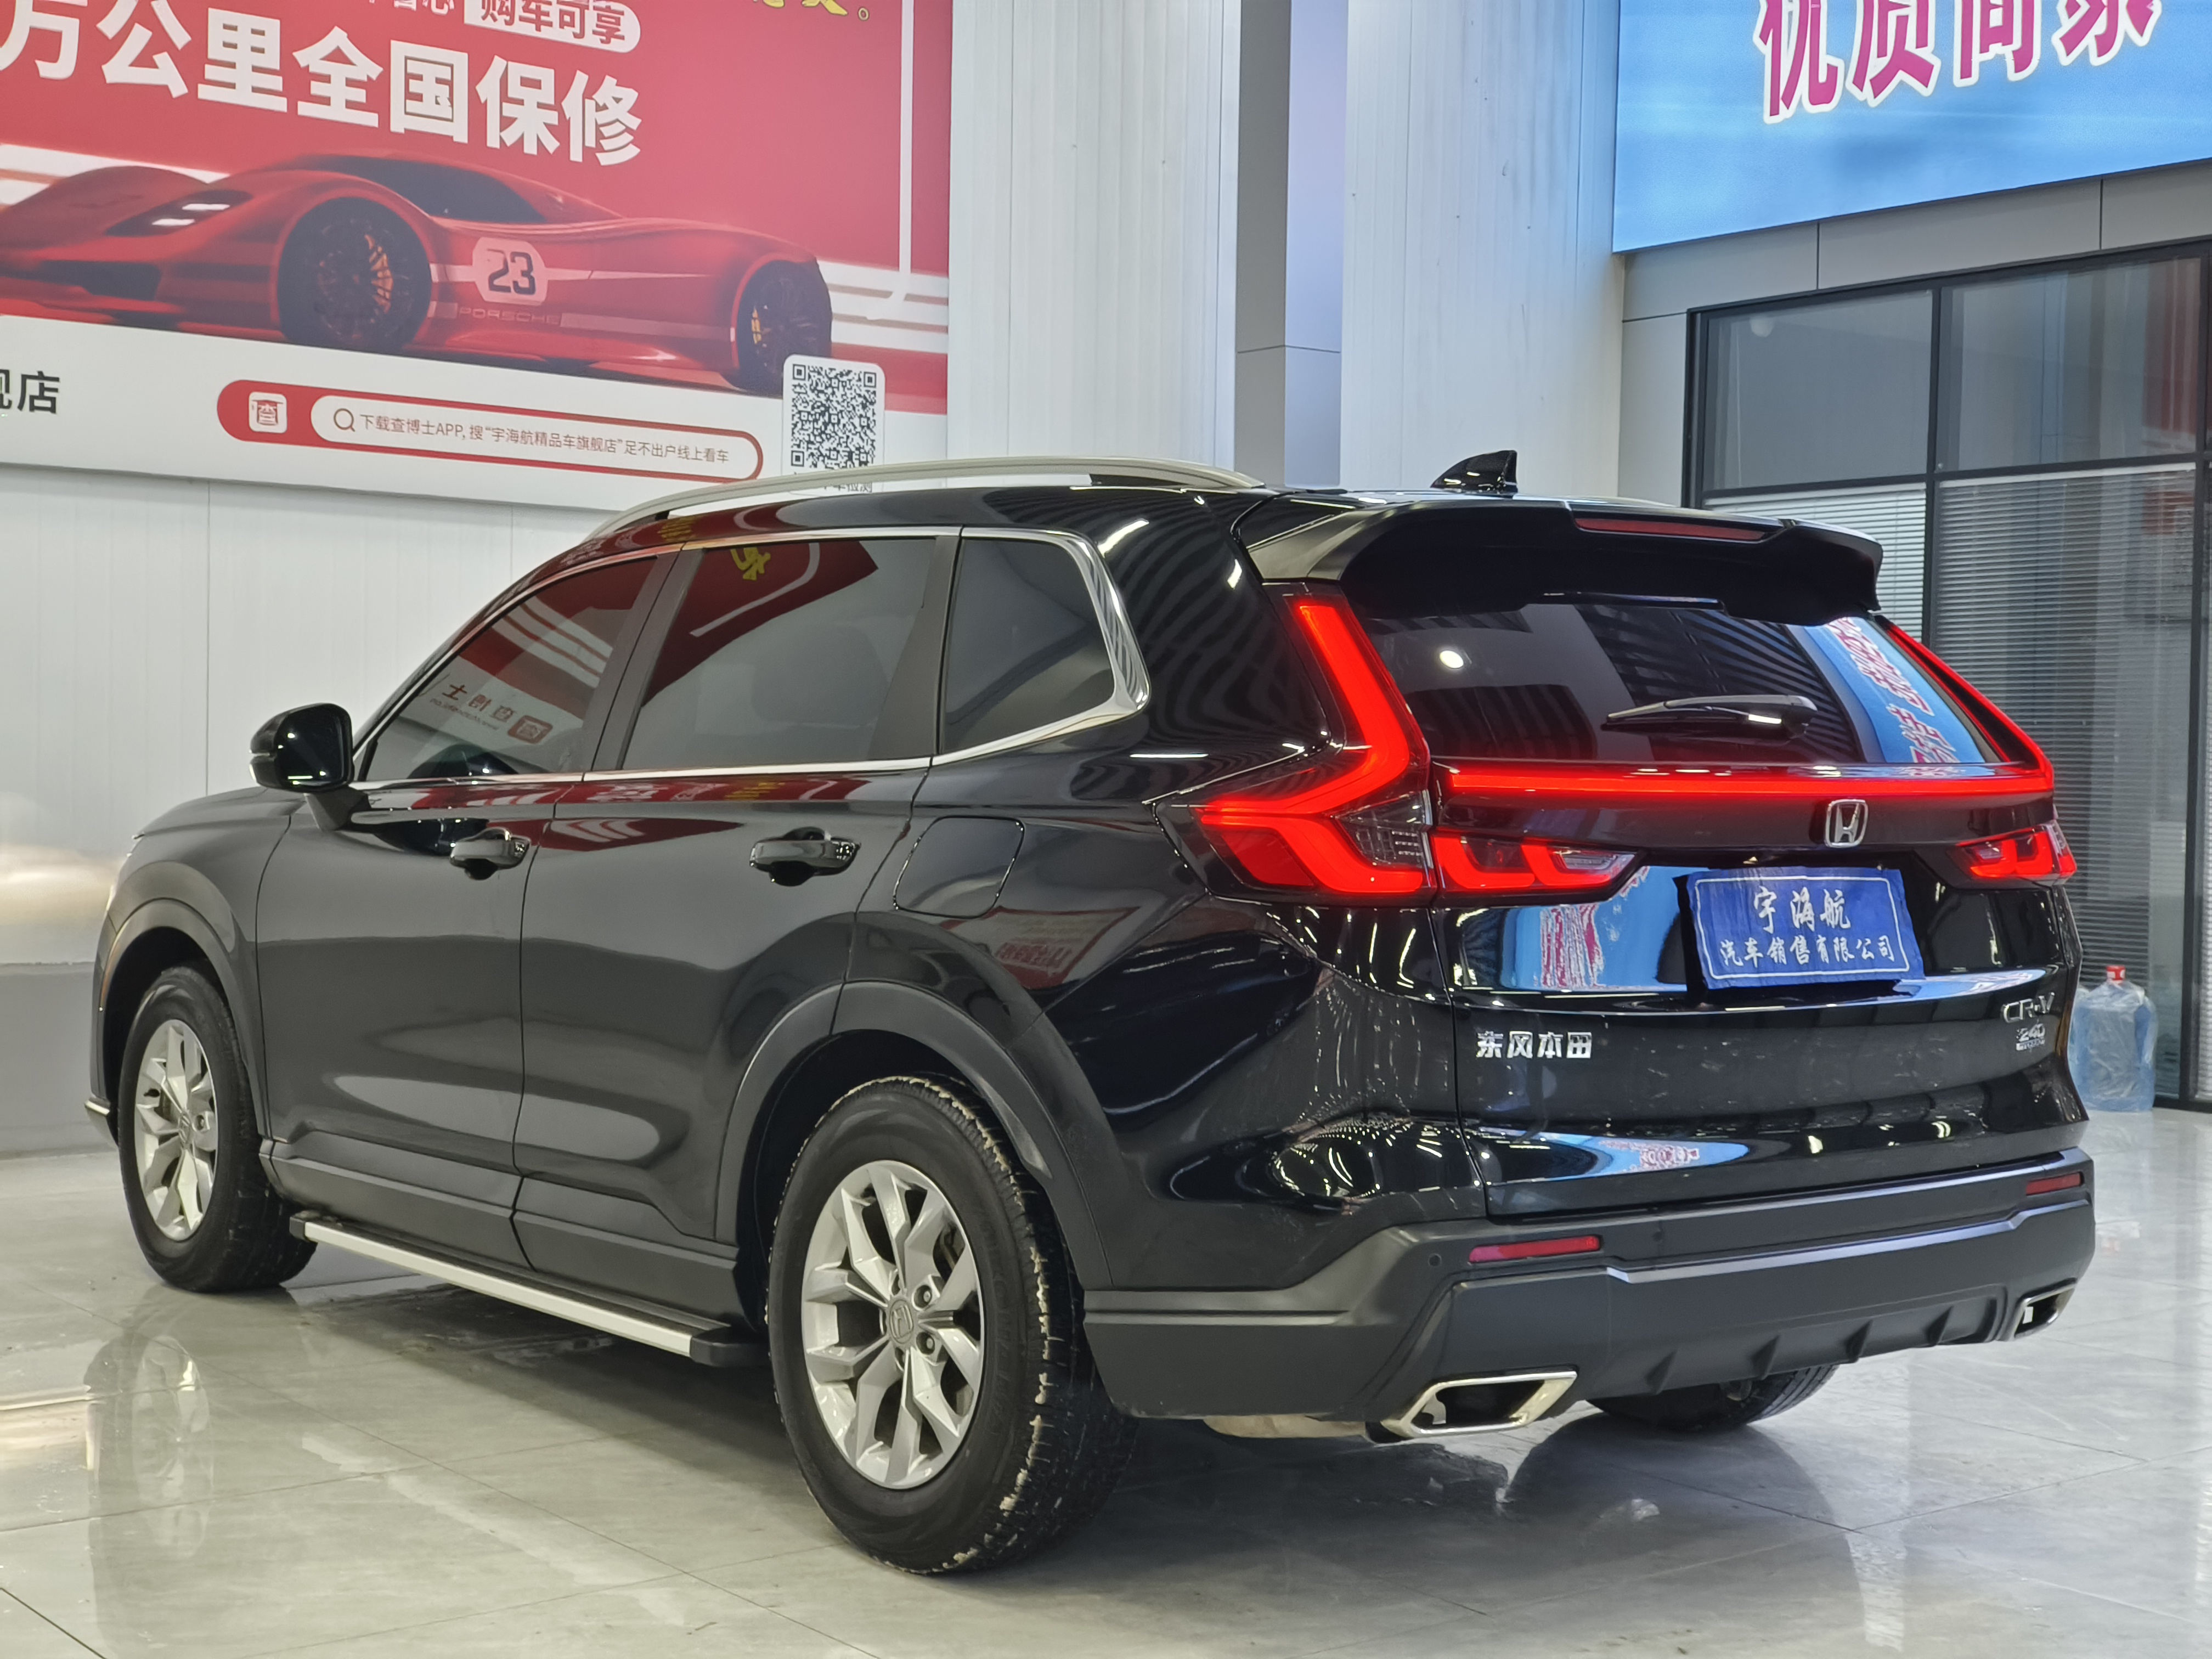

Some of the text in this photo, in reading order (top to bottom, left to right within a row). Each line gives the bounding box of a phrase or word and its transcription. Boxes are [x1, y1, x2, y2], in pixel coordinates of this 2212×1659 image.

[487, 249, 536, 296] 23
[1753, 885, 1851, 934] 宇海航
[1719, 935, 1895, 968] 汽车销售有限公司
[1476, 1031, 1592, 1059] 东风本田
